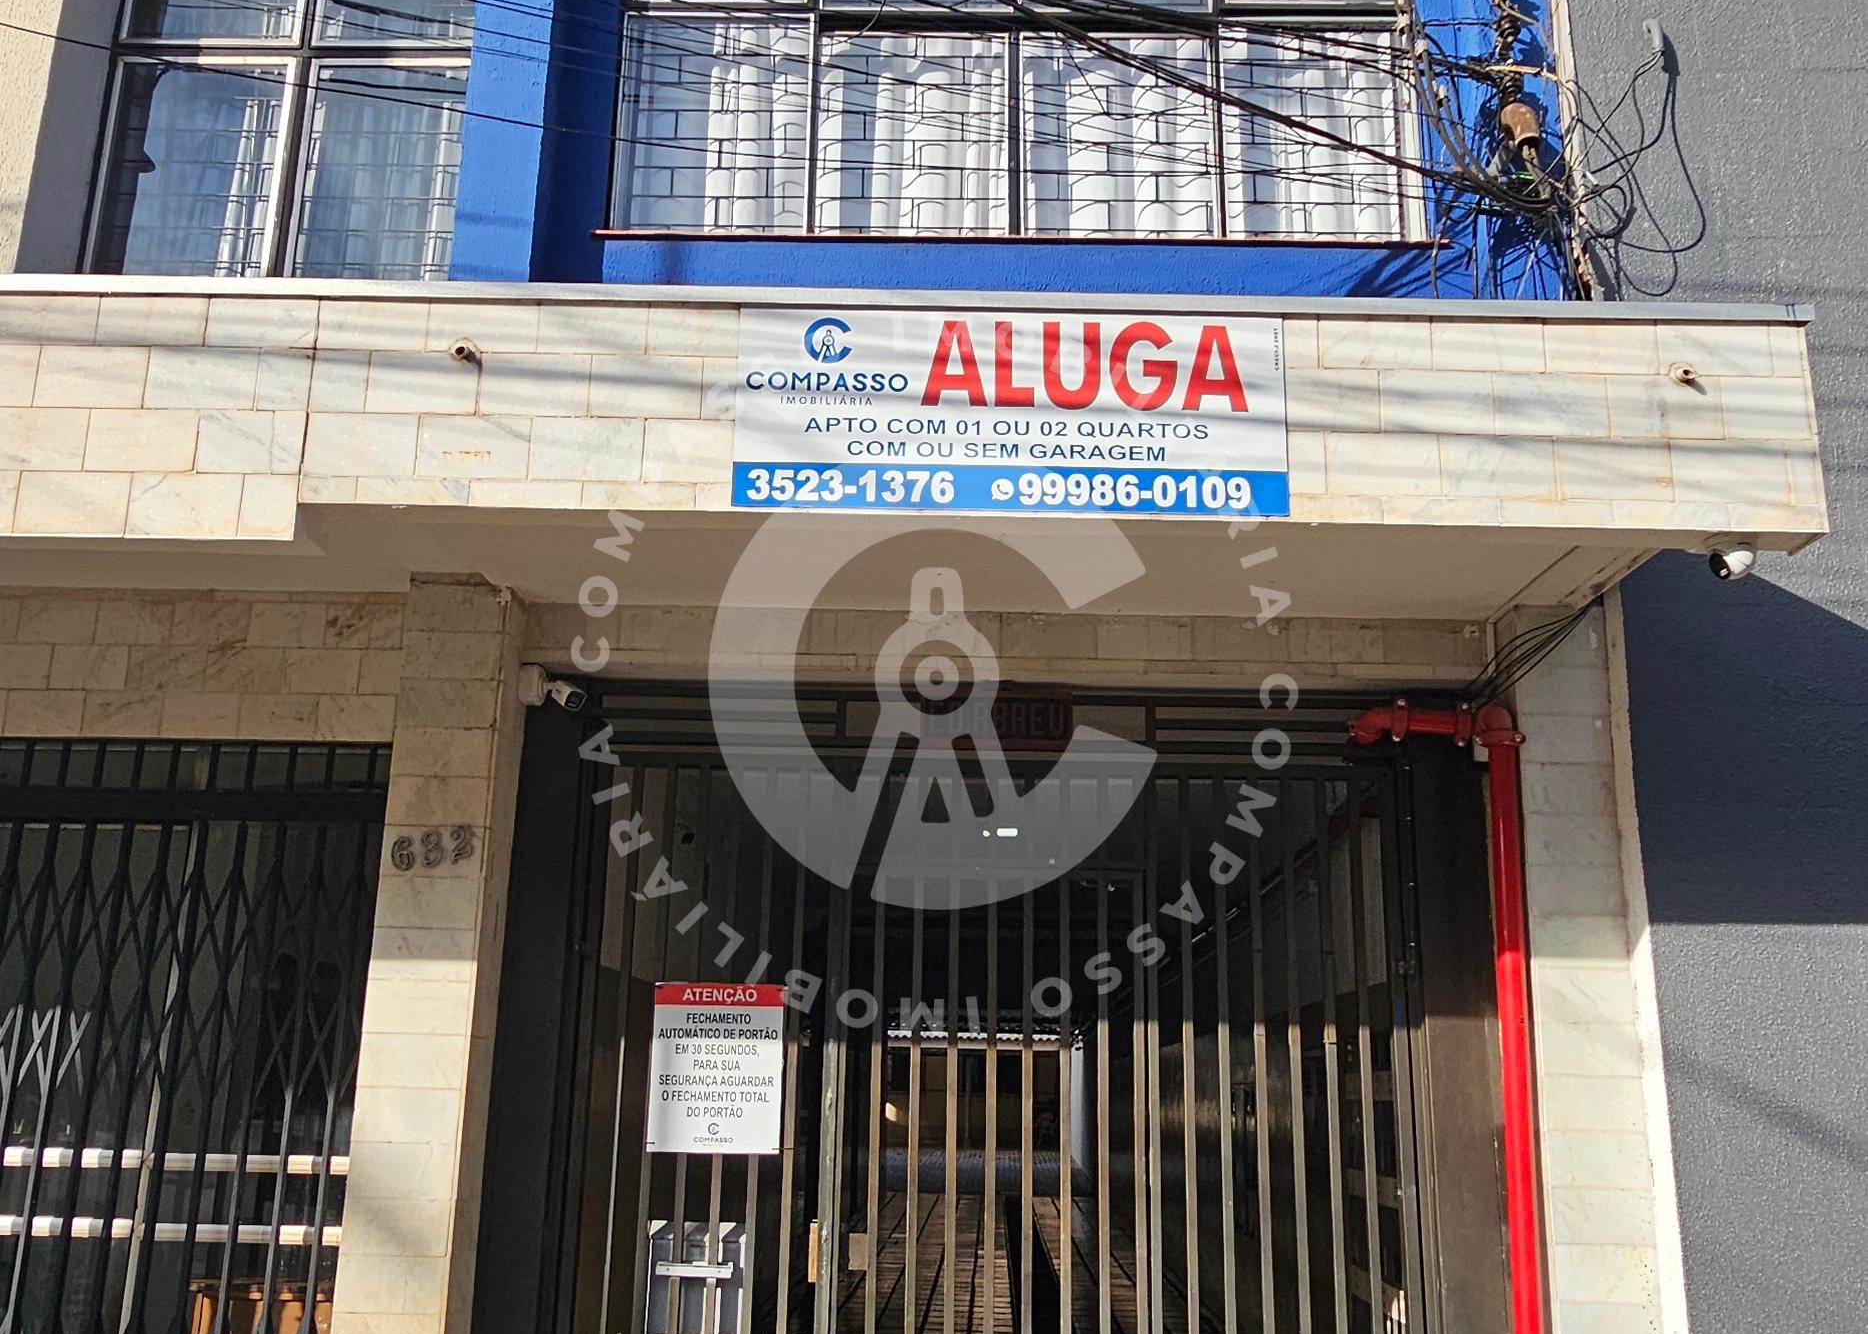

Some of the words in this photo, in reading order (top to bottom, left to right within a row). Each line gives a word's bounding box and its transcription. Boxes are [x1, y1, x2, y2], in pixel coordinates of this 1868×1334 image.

[920, 319, 1249, 413] ALUGA
[746, 370, 909, 394] COMPASSO
[779, 394, 873, 407] IMOBILIÁRIA
[804, 416, 878, 434] APTO
[886, 418, 948, 436] COM
[955, 419, 982, 436] 01
[992, 419, 1031, 437] OU
[1039, 420, 1068, 437] 02
[1076, 420, 1210, 440] QUARTOS
[846, 440, 907, 457] COM
[916, 442, 953, 458] OU
[962, 442, 1020, 459] SEM
[1028, 443, 1167, 463] GARAGEM
[746, 468, 955, 504] 3523-1376
[1018, 472, 1252, 510] 99986-0109
[683, 986, 757, 1004] ATENÇÃO
[686, 1012, 751, 1025] FECHAMENTO
[658, 1026, 720, 1040] AUTOMÁTICO
[724, 1029, 736, 1039] DE
[739, 1027, 778, 1040] PORTÃO
[675, 1044, 689, 1054] EM
[692, 1044, 702, 1054] 30
[704, 1044, 760, 1057] SEGUNDOS,
[693, 1060, 718, 1071] PARA
[721, 1060, 740, 1071] SUA
[659, 1074, 717, 1087] SEGURANÇA
[720, 1076, 774, 1087] AGUARDAR
[661, 1090, 669, 1101] O
[671, 1090, 737, 1102] FECHAMENTO
[740, 1091, 769, 1103] TOTAL
[686, 1106, 700, 1118] DO
[703, 1105, 743, 1118] PORTÃO
